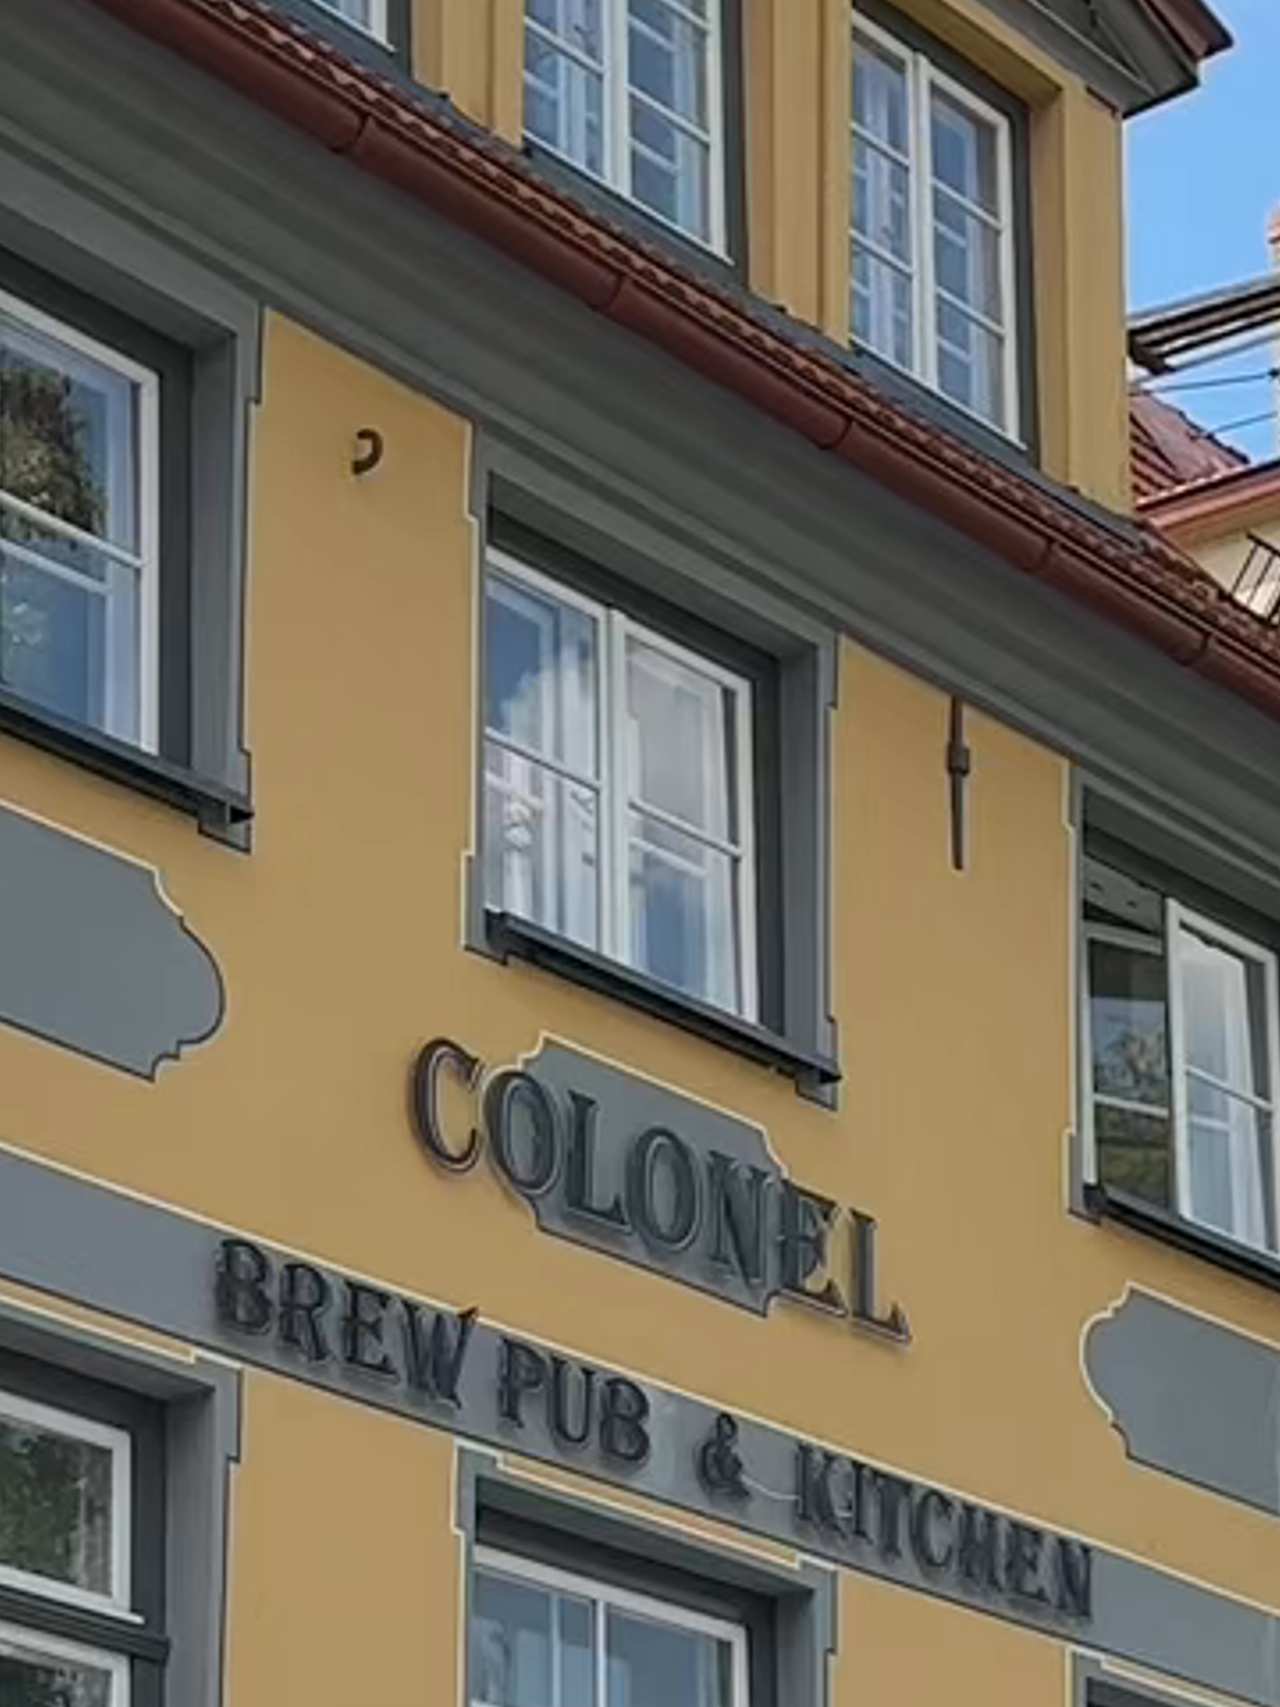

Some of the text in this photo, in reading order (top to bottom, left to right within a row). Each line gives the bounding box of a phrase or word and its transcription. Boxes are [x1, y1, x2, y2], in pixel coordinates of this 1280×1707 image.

[411, 1037, 911, 1344] COLONEL
[216, 1238, 1092, 1619] BREW PUB & KITCHEN
